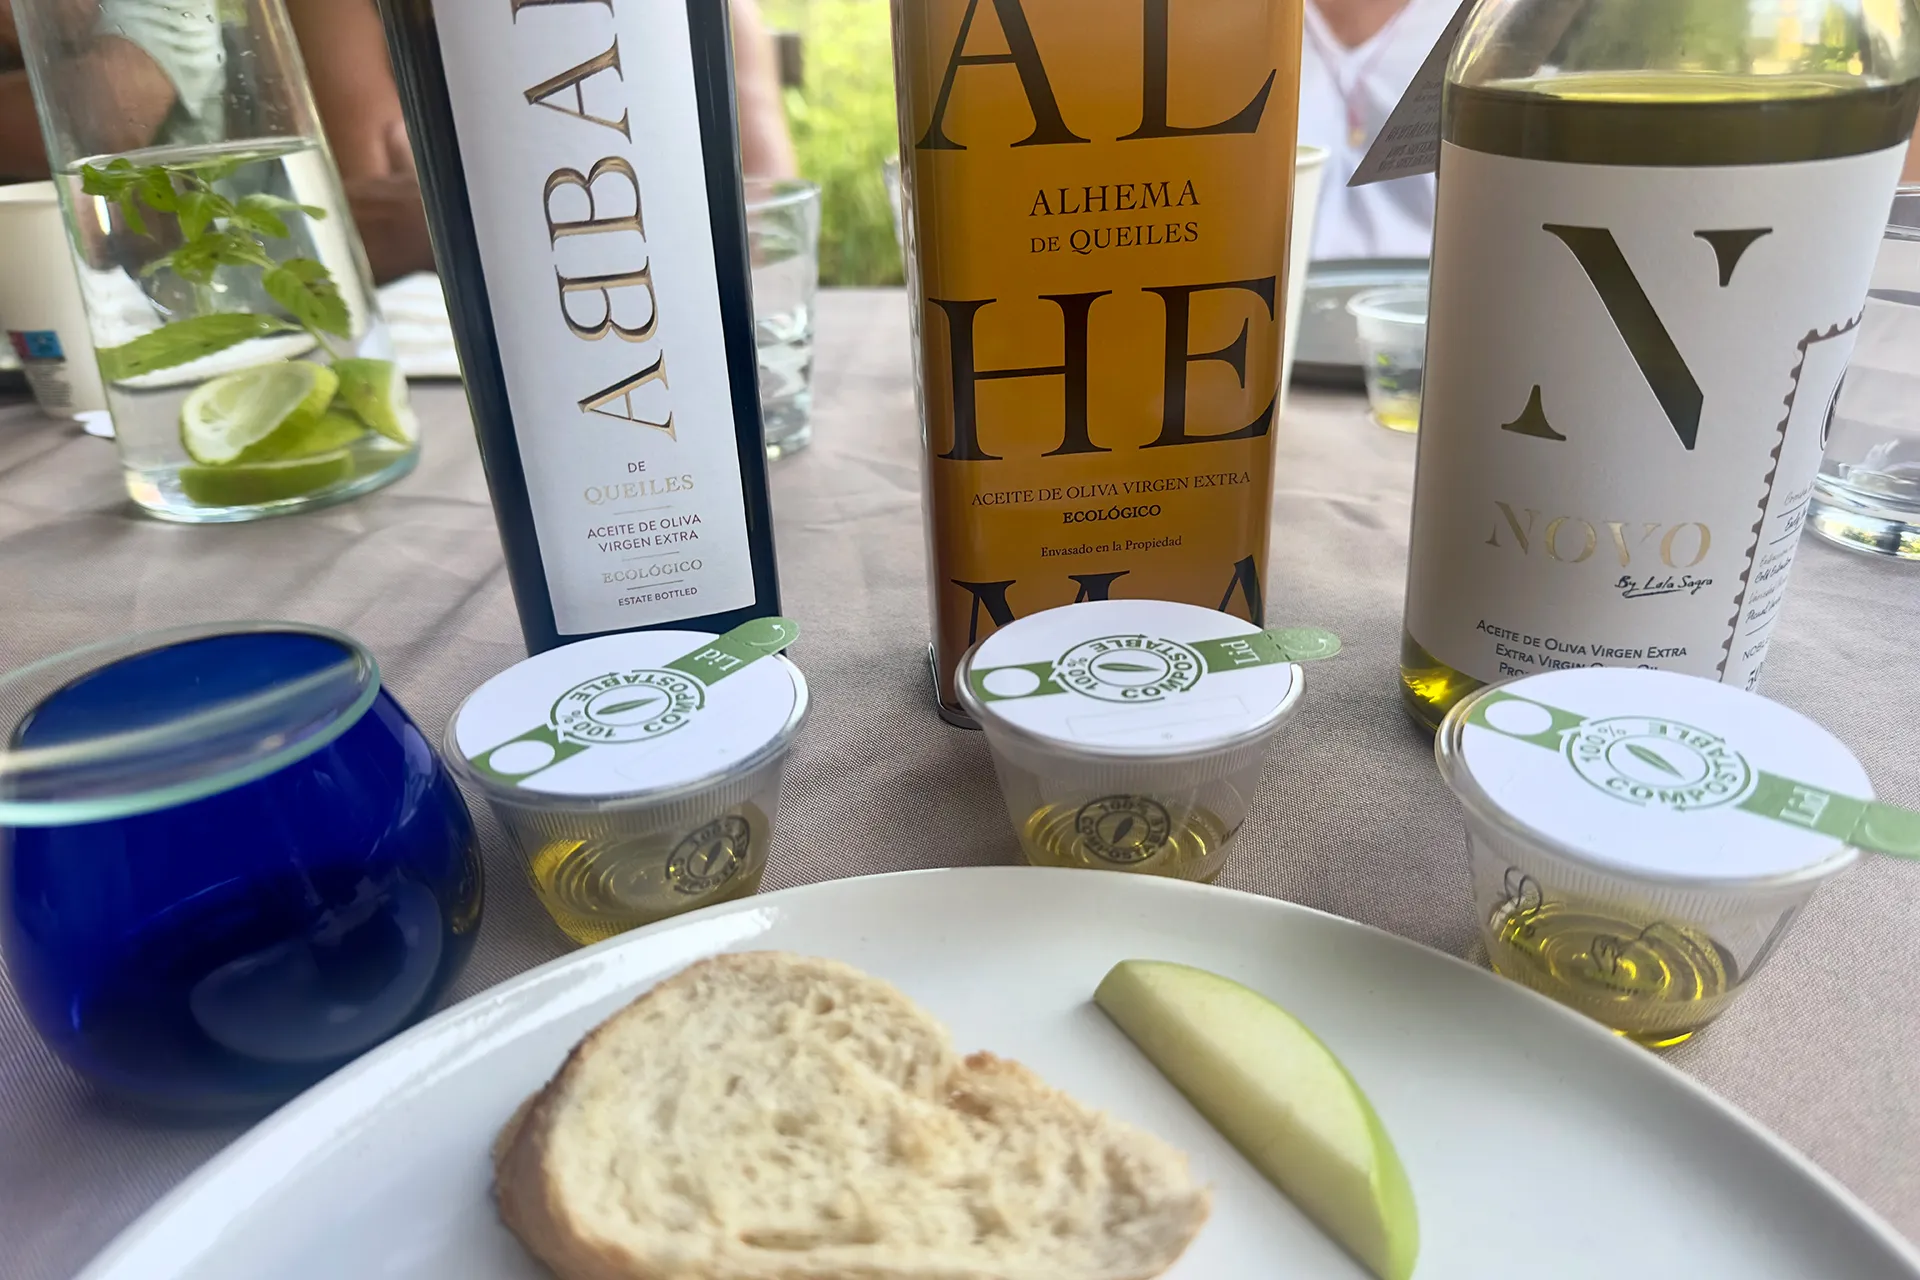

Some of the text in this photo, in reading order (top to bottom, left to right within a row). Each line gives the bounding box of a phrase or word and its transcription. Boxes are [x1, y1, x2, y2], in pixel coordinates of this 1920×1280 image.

[1028, 179, 1201, 217] ALHEMA
[1030, 221, 1200, 255] DE QUEILES
[1501, 223, 1773, 450] N
[928, 275, 1280, 461] HE
[627, 461, 646, 473] DE
[583, 474, 694, 505] QUEILES
[971, 471, 1251, 506] ACEITE DE OLIVA VIRGEN EXTRA
[587, 514, 701, 539] ACEITE DE OLIVA
[1062, 504, 1162, 524] ECOLÓGICO
[598, 530, 699, 552] VIRGEN EXTRA
[1041, 535, 1182, 557] Envasado en la Propiedad
[1484, 500, 1711, 569] NOVO
[601, 559, 703, 584] ECOLÓGICO
[1614, 575, 1639, 597] By
[1677, 575, 1713, 595] Sagra
[618, 587, 698, 606] ESTATE BOTTLED
[1220, 639, 1262, 666] Lid
[1476, 619, 1519, 642] ACEITE
[1544, 638, 1586, 656] OLIVA
[1591, 644, 1642, 659] VIRGEN
[1647, 646, 1687, 659] EXTRA
[1495, 643, 1535, 665] EXTRA
[693, 648, 744, 672] Lid
[1066, 657, 1099, 691] 100%
[1089, 638, 1193, 699] COMPOSTABLE
[568, 673, 696, 733] COMPOSTABLE
[563, 709, 617, 739] 100%
[1579, 724, 1627, 763] 100%
[1779, 785, 1831, 828] Lid
